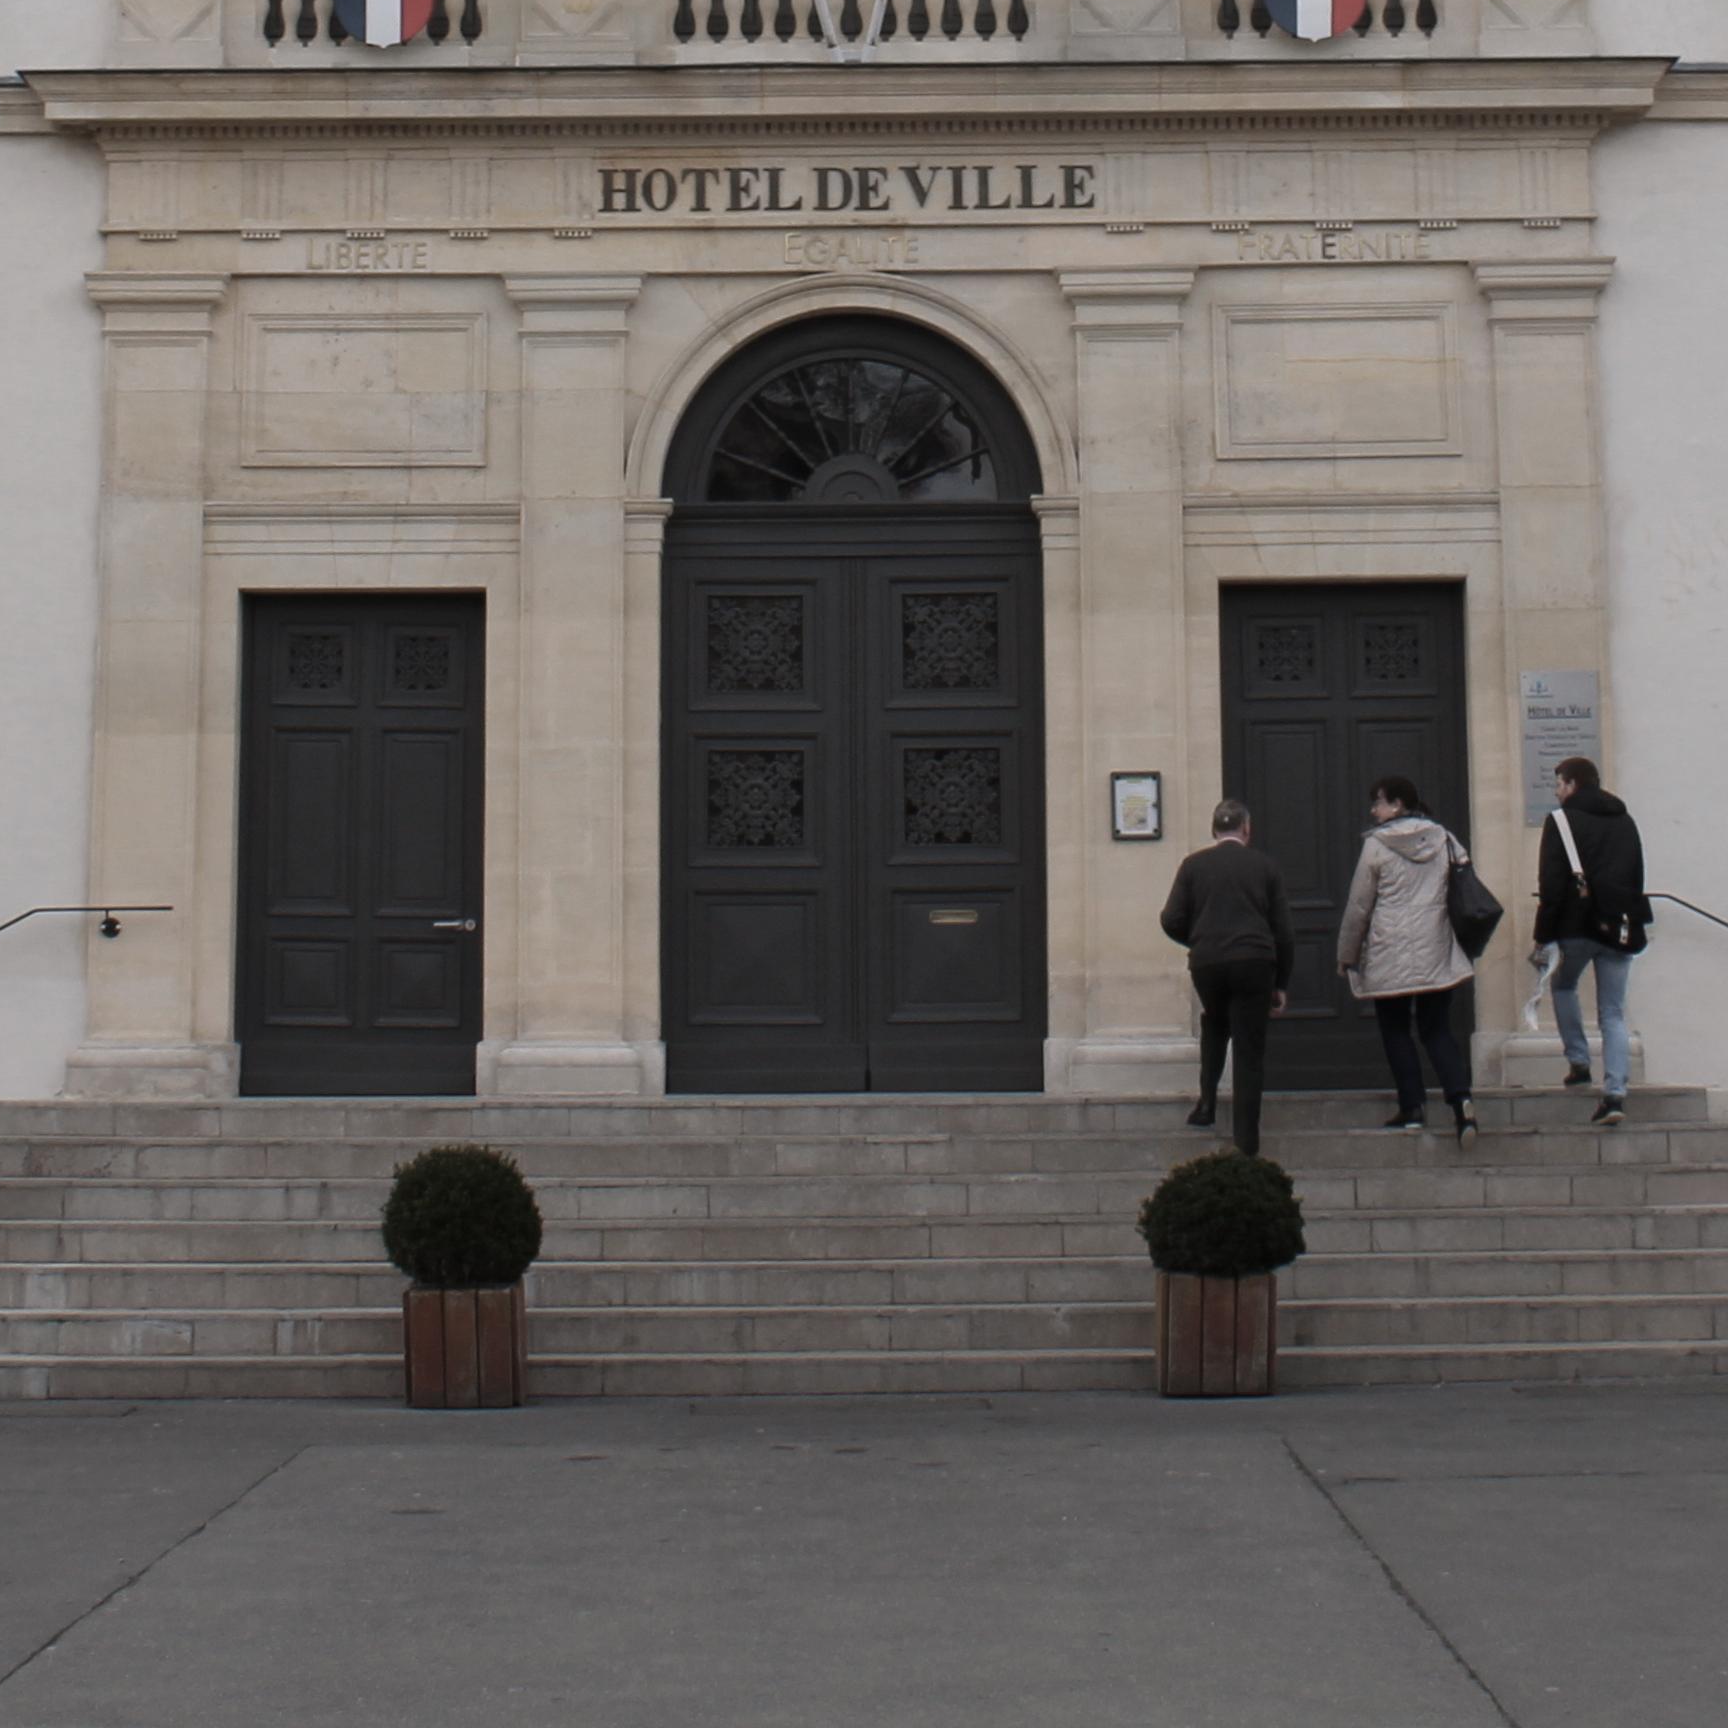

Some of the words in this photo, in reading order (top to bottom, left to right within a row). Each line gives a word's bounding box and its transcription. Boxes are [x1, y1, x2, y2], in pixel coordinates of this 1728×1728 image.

[597, 167, 803, 213] HOTEL
[812, 166, 890, 212] DE
[897, 164, 1096, 210] VILLE
